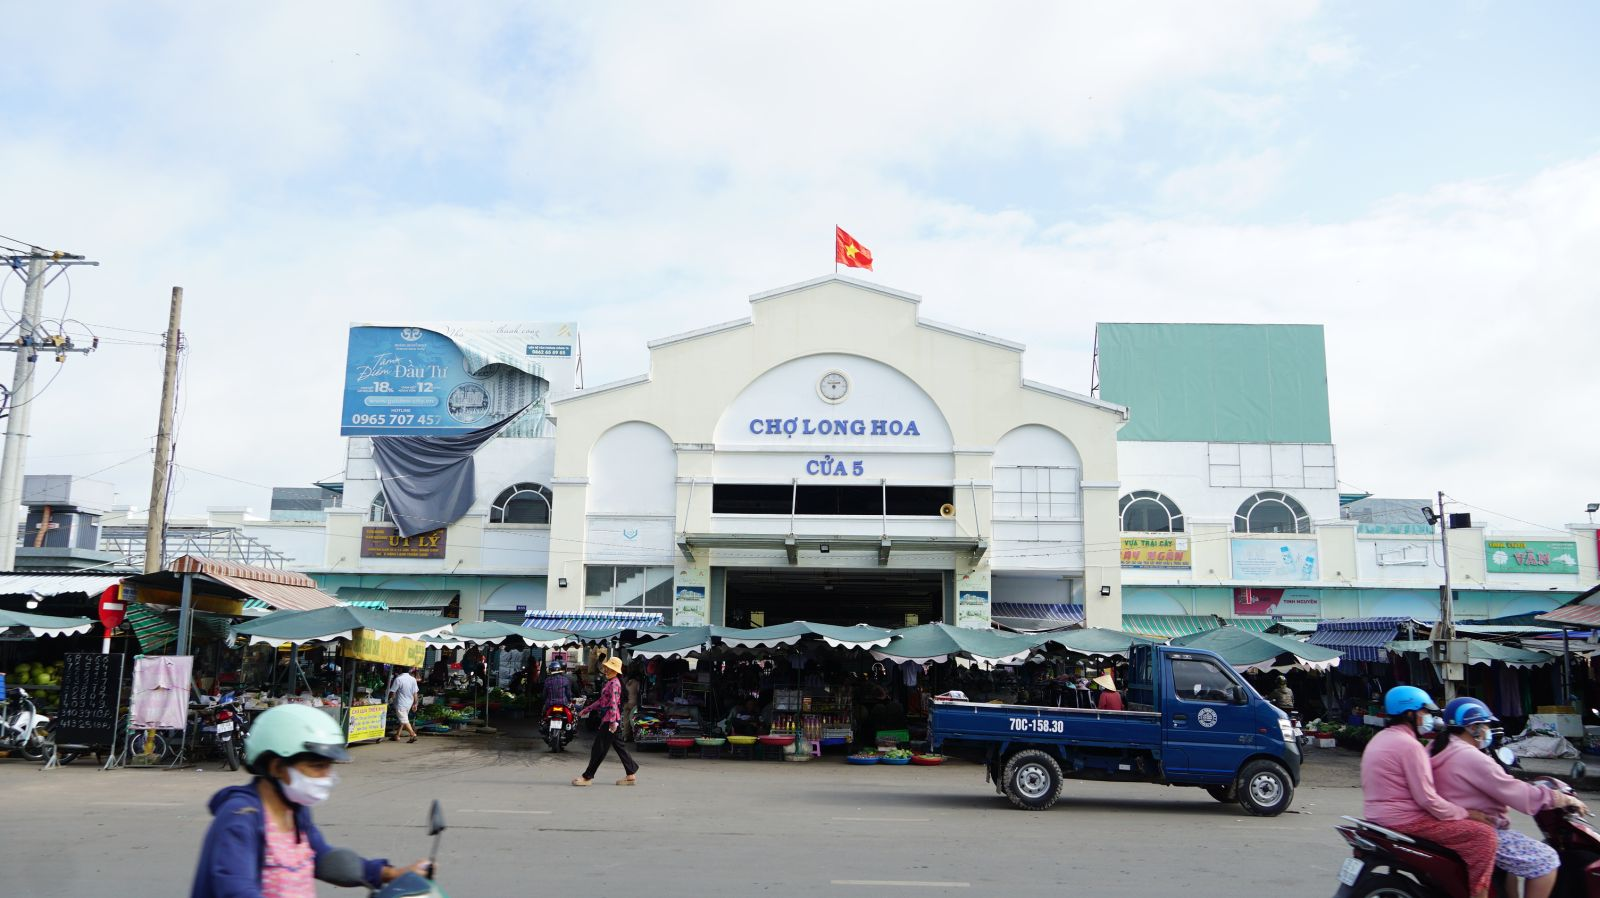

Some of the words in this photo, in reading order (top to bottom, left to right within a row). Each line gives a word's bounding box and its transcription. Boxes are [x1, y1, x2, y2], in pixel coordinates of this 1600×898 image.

[394, 359, 424, 378] Đầu
[428, 365, 449, 378] Tư
[416, 382, 434, 393] 12
[352, 414, 386, 425] 0965
[389, 414, 415, 425] 707
[417, 414, 442, 425] 457
[749, 417, 798, 439] CHỢ
[802, 419, 866, 437] LONG
[870, 420, 920, 437] HOA
[806, 454, 848, 477] CỬA
[852, 460, 864, 477] 5
[419, 534, 440, 547] LÝ
[1009, 718, 1064, 733] 70C-158.30
